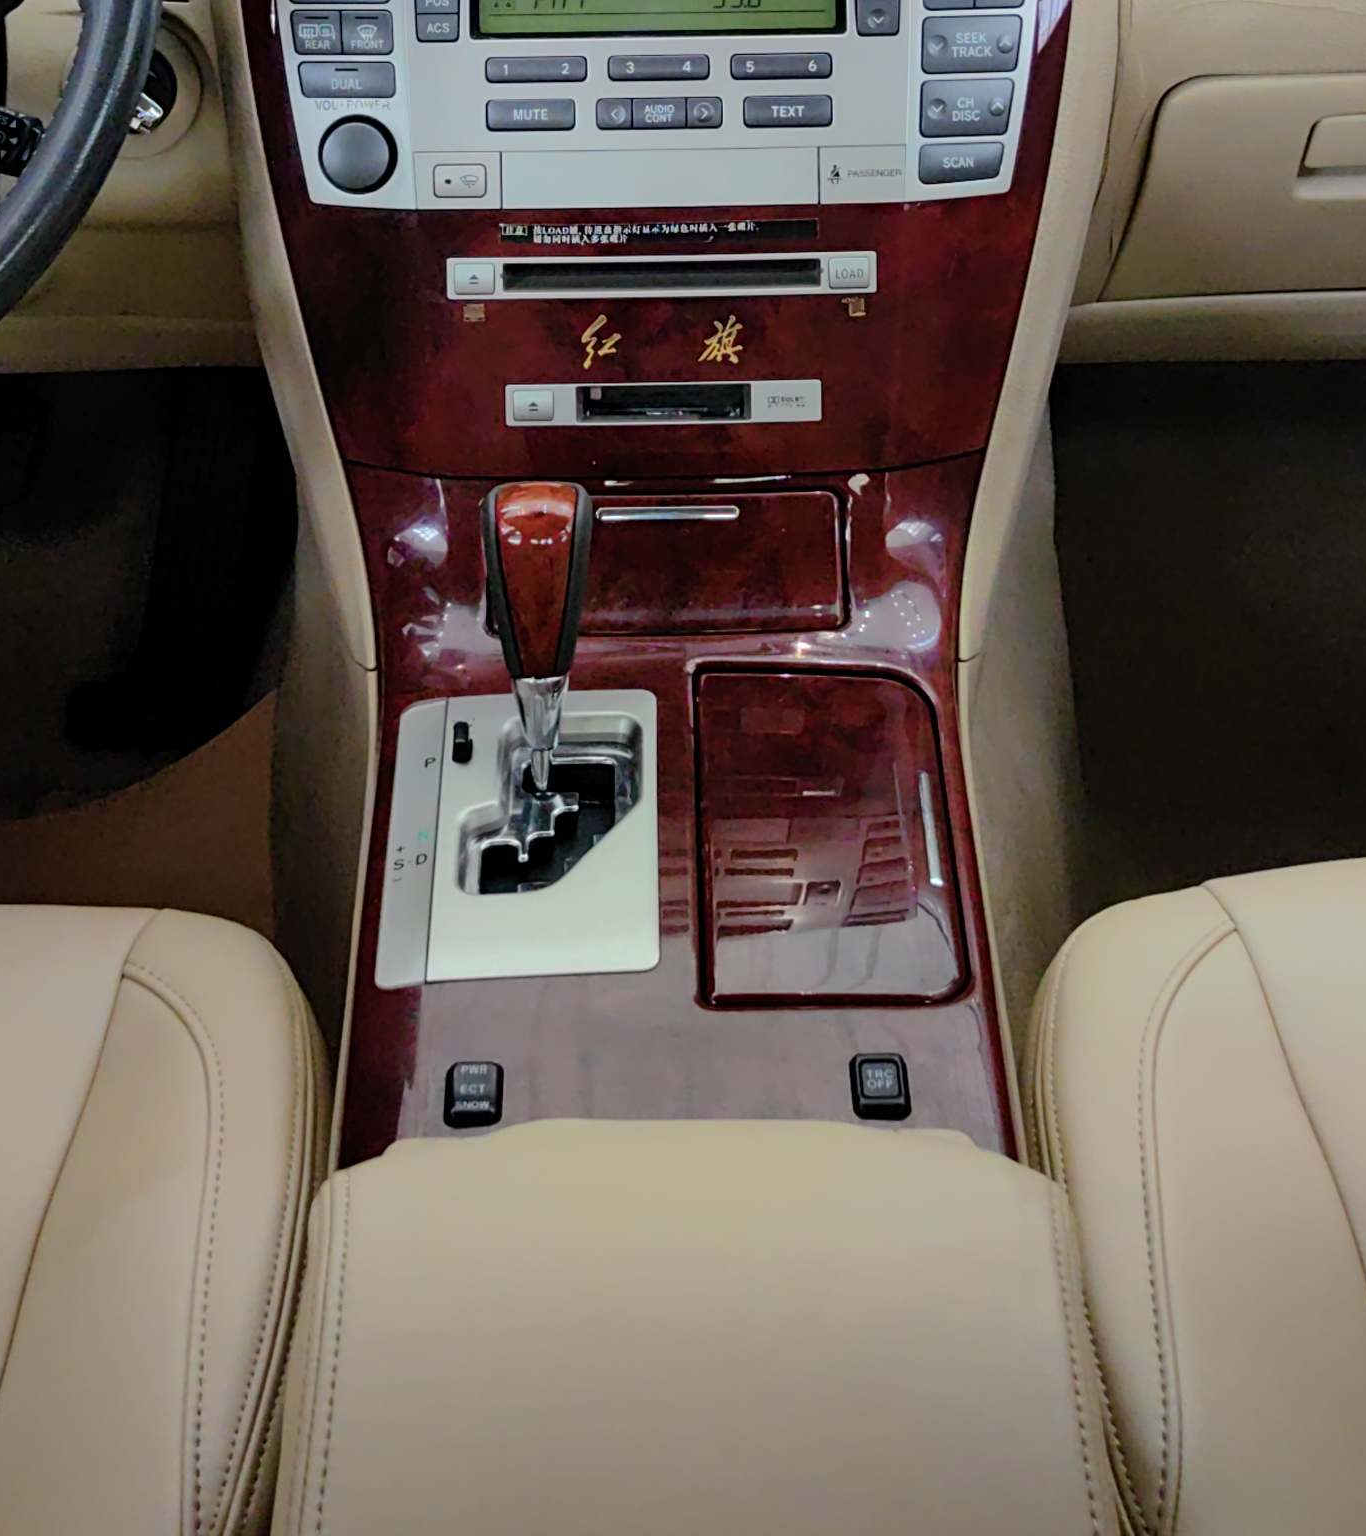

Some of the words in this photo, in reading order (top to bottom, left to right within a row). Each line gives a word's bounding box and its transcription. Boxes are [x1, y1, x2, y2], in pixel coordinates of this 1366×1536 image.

[426, 22, 451, 34] ACS
[955, 32, 987, 44] SEEK
[304, 40, 331, 50] REAR
[350, 39, 385, 50] FRONT
[951, 45, 993, 58] TRACK
[502, 64, 510, 76] 1
[561, 63, 570, 75] 2
[625, 61, 636, 74] 3
[682, 60, 692, 73] 4
[745, 60, 756, 73] 5
[807, 59, 819, 73] 6
[331, 78, 363, 90] DUAL
[644, 104, 675, 114] AUDIO
[956, 97, 974, 109] CH
[513, 109, 548, 121] MUTE
[771, 105, 805, 118] TEXT
[952, 110, 980, 122] DISC
[645, 113, 673, 123] CONT
[942, 157, 974, 168] SCAN
[847, 168, 902, 178] PASSENGER
[835, 267, 864, 280] LOAD
[425, 757, 436, 768] P
[417, 830, 429, 841] N
[415, 854, 428, 865] D
[461, 1064, 488, 1074] PWR
[867, 1069, 894, 1078] TRC
[460, 1084, 485, 1094] ECT
[866, 1079, 894, 1089] OFF
[455, 1101, 490, 1109] SNOW
